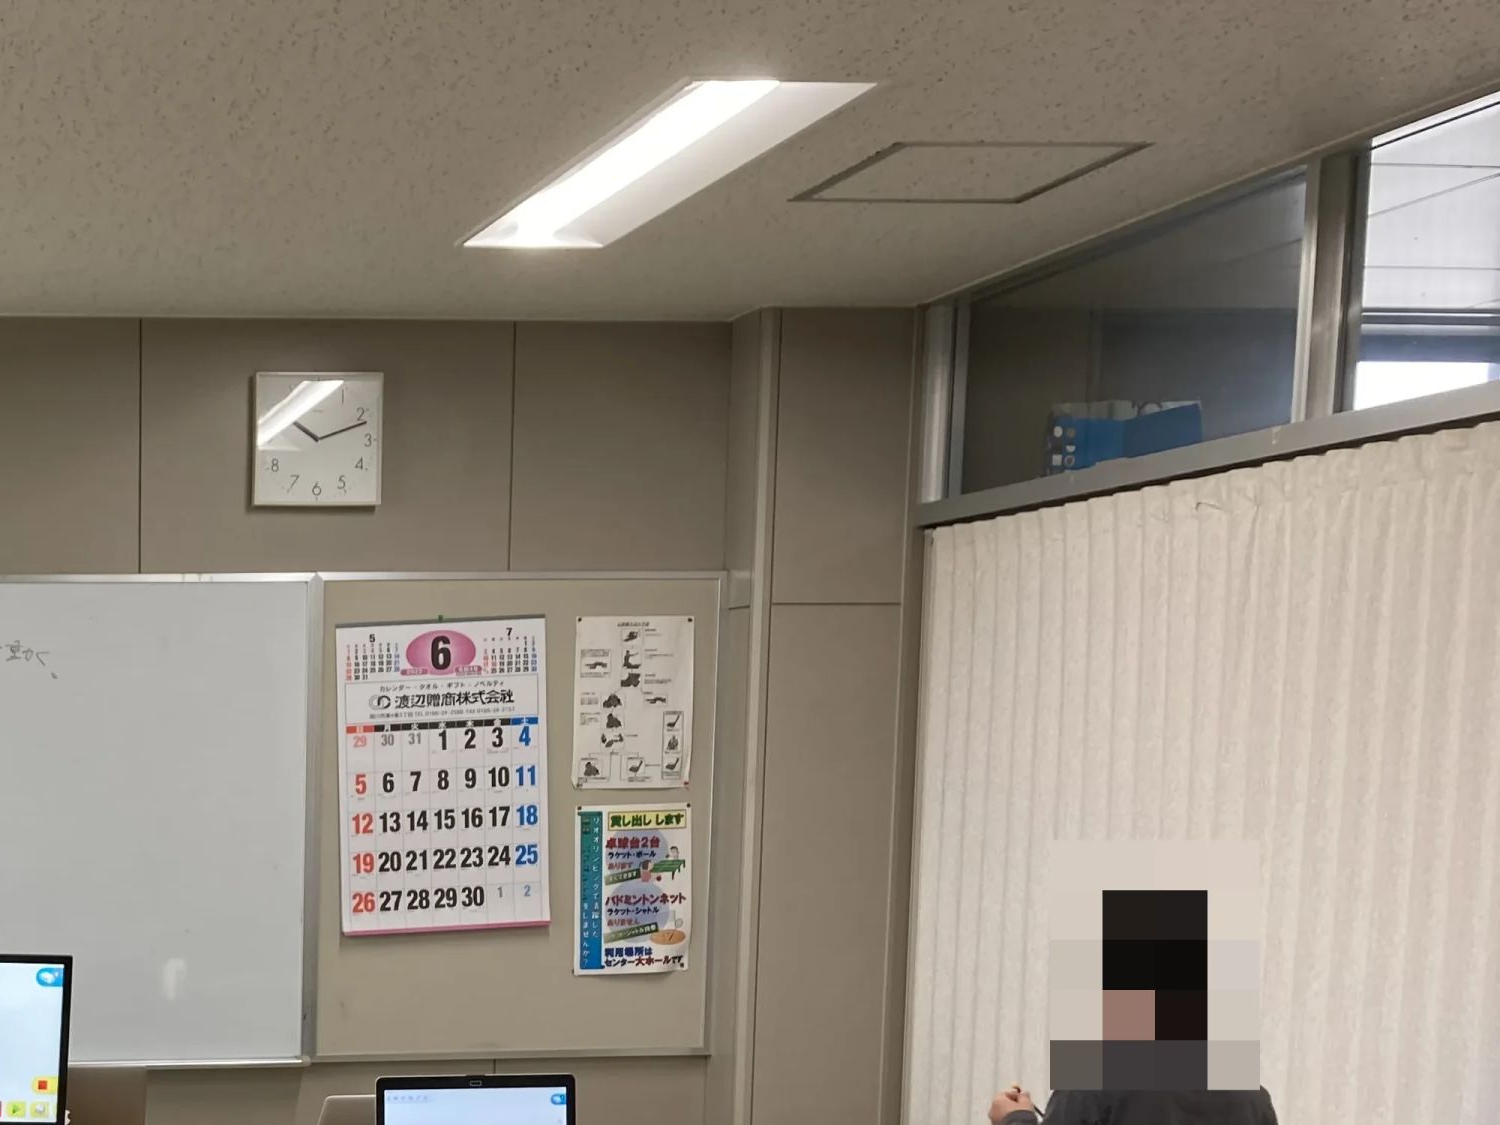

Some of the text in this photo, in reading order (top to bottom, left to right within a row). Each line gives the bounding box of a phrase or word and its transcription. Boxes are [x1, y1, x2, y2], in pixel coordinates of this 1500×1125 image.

[357, 407, 365, 421] 2
[364, 433, 372, 447] 3
[271, 458, 279, 472] 8
[355, 457, 363, 470] 4
[290, 474, 300, 493] 7
[312, 482, 322, 496] 6
[337, 475, 346, 490] 5
[370, 634, 376, 643] 5
[506, 628, 512, 636] 7
[430, 635, 452, 670] 6
[354, 726, 531, 750] 29 30 31 1 2 3 4
[356, 765, 536, 794] 5 6 7 8 9 10 11
[352, 805, 538, 834] 12 13 14 15 16 17 18
[353, 844, 538, 874] 19 20 21 22 23 24 25
[353, 886, 531, 913] 26 27 28 29 30 1 2
